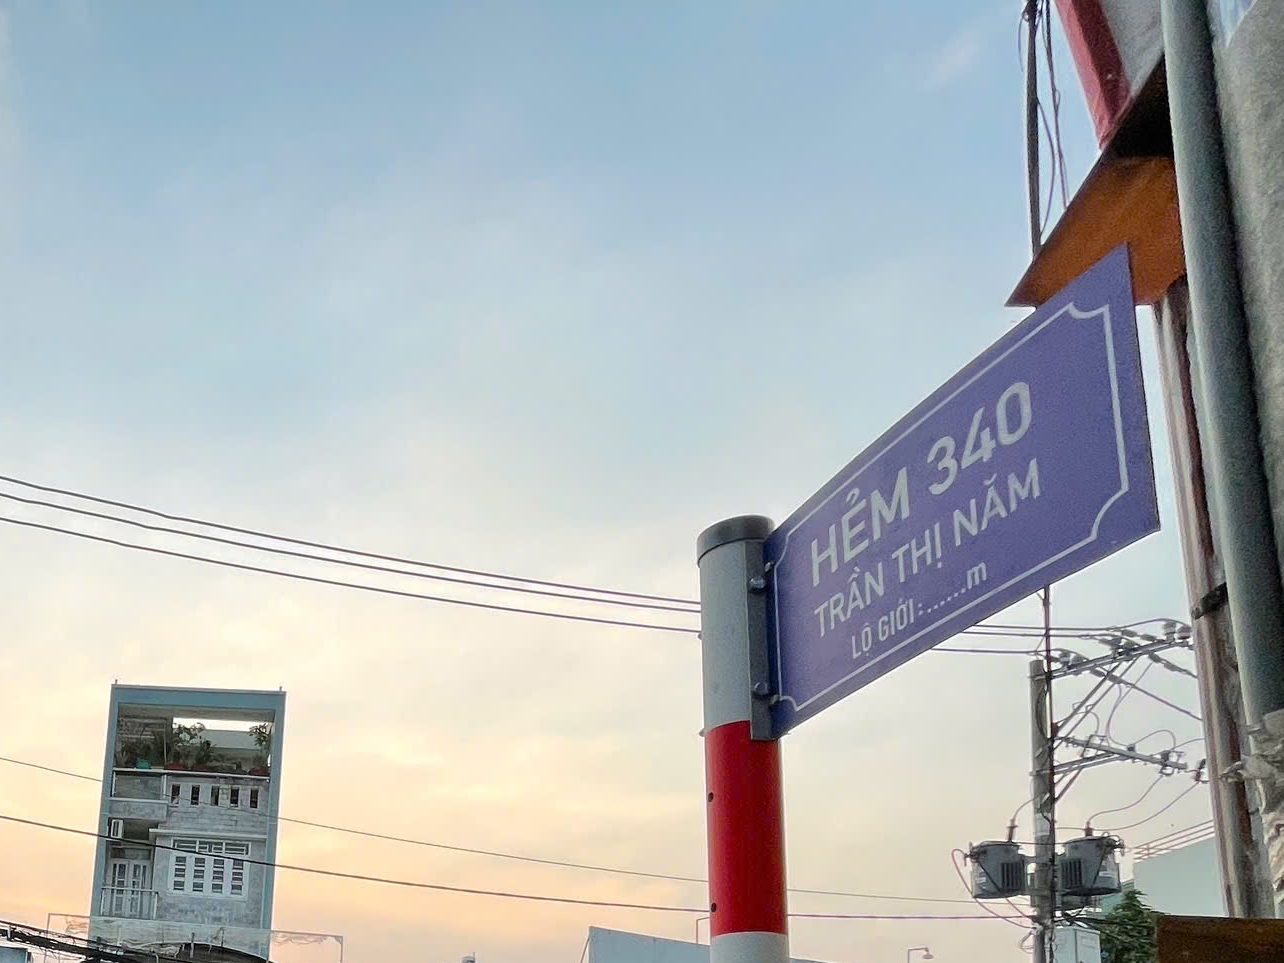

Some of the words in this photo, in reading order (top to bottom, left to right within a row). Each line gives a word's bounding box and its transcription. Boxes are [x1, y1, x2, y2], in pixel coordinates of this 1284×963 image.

[811, 467, 910, 588] HẺM
[927, 381, 1033, 495] 340
[814, 562, 885, 638] TRẦN
[892, 522, 942, 582] THỊ
[954, 457, 1041, 547] NĂM
[852, 623, 873, 660] LỘ
